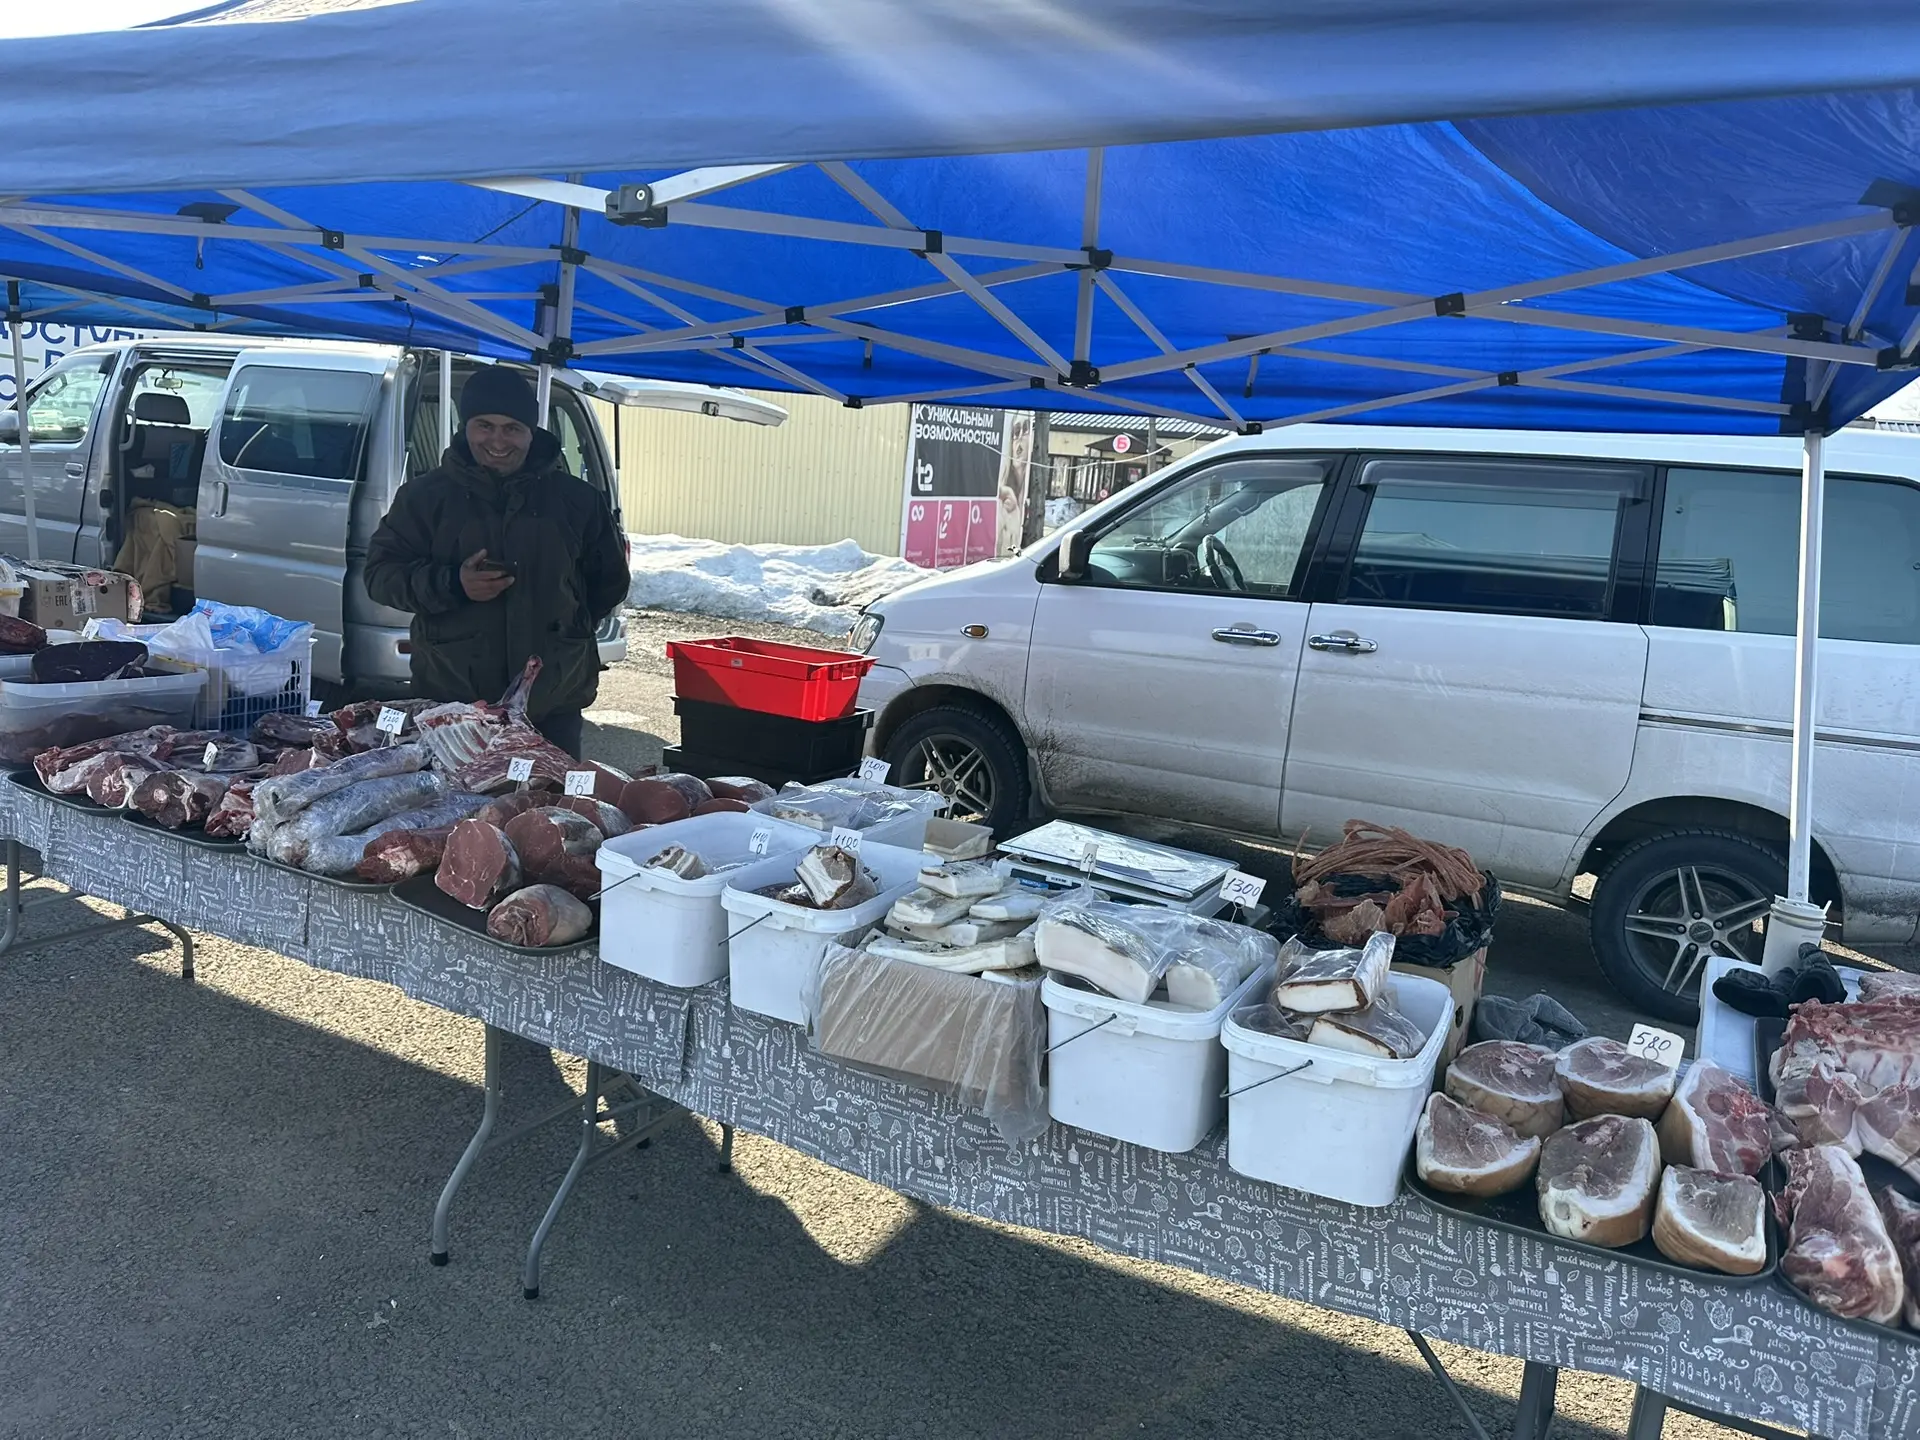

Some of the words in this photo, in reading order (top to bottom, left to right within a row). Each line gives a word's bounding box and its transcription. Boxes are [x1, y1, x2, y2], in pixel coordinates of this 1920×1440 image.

[916, 405, 924, 420] К
[927, 406, 994, 428] УНИКАЛЬНЫМ
[916, 424, 1000, 445] ВОЗМОЖНОСТЯМ
[1117, 438, 1127, 449] Б
[865, 760, 885, 771] 1200
[568, 774, 590, 786] 970
[1223, 878, 1260, 896] 1300
[1633, 1032, 1671, 1050] 580
[1487, 1228, 1499, 1262] Кухня
[1557, 1255, 1577, 1265] руки
[1580, 1259, 1602, 1271] моем
[1507, 1281, 1548, 1299] Приятного
[1604, 1275, 1617, 1318] Испачкал
[1435, 1296, 1489, 1314] Готовим
[1508, 1298, 1549, 1313] аппетита!
[1768, 1340, 1791, 1352] Сэр!
[1750, 1349, 1807, 1372] Овсянка
